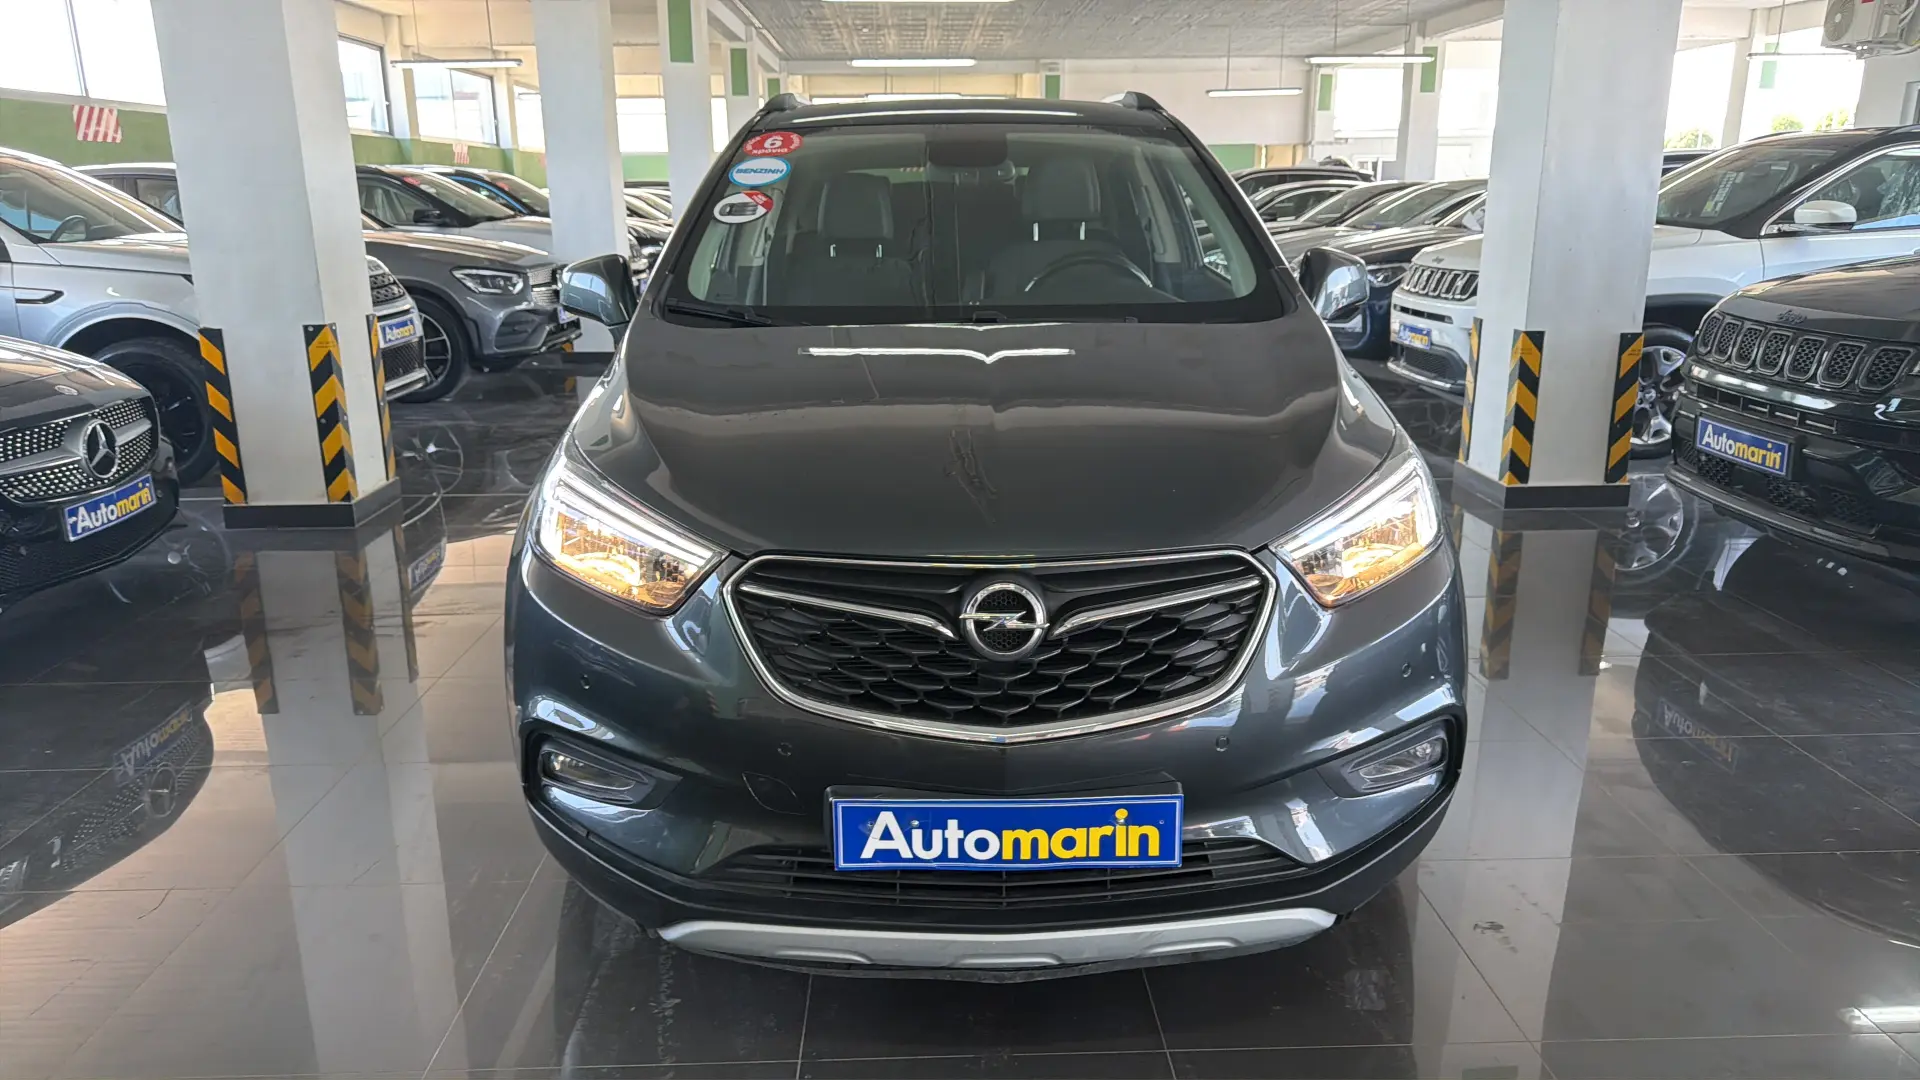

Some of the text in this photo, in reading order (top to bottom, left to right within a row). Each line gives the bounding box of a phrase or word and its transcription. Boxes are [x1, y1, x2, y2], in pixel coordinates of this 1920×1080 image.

[763, 136, 784, 149] 6
[1701, 424, 1782, 470] Automarin
[77, 483, 152, 534] Automarin
[860, 808, 1160, 860] Automarin
